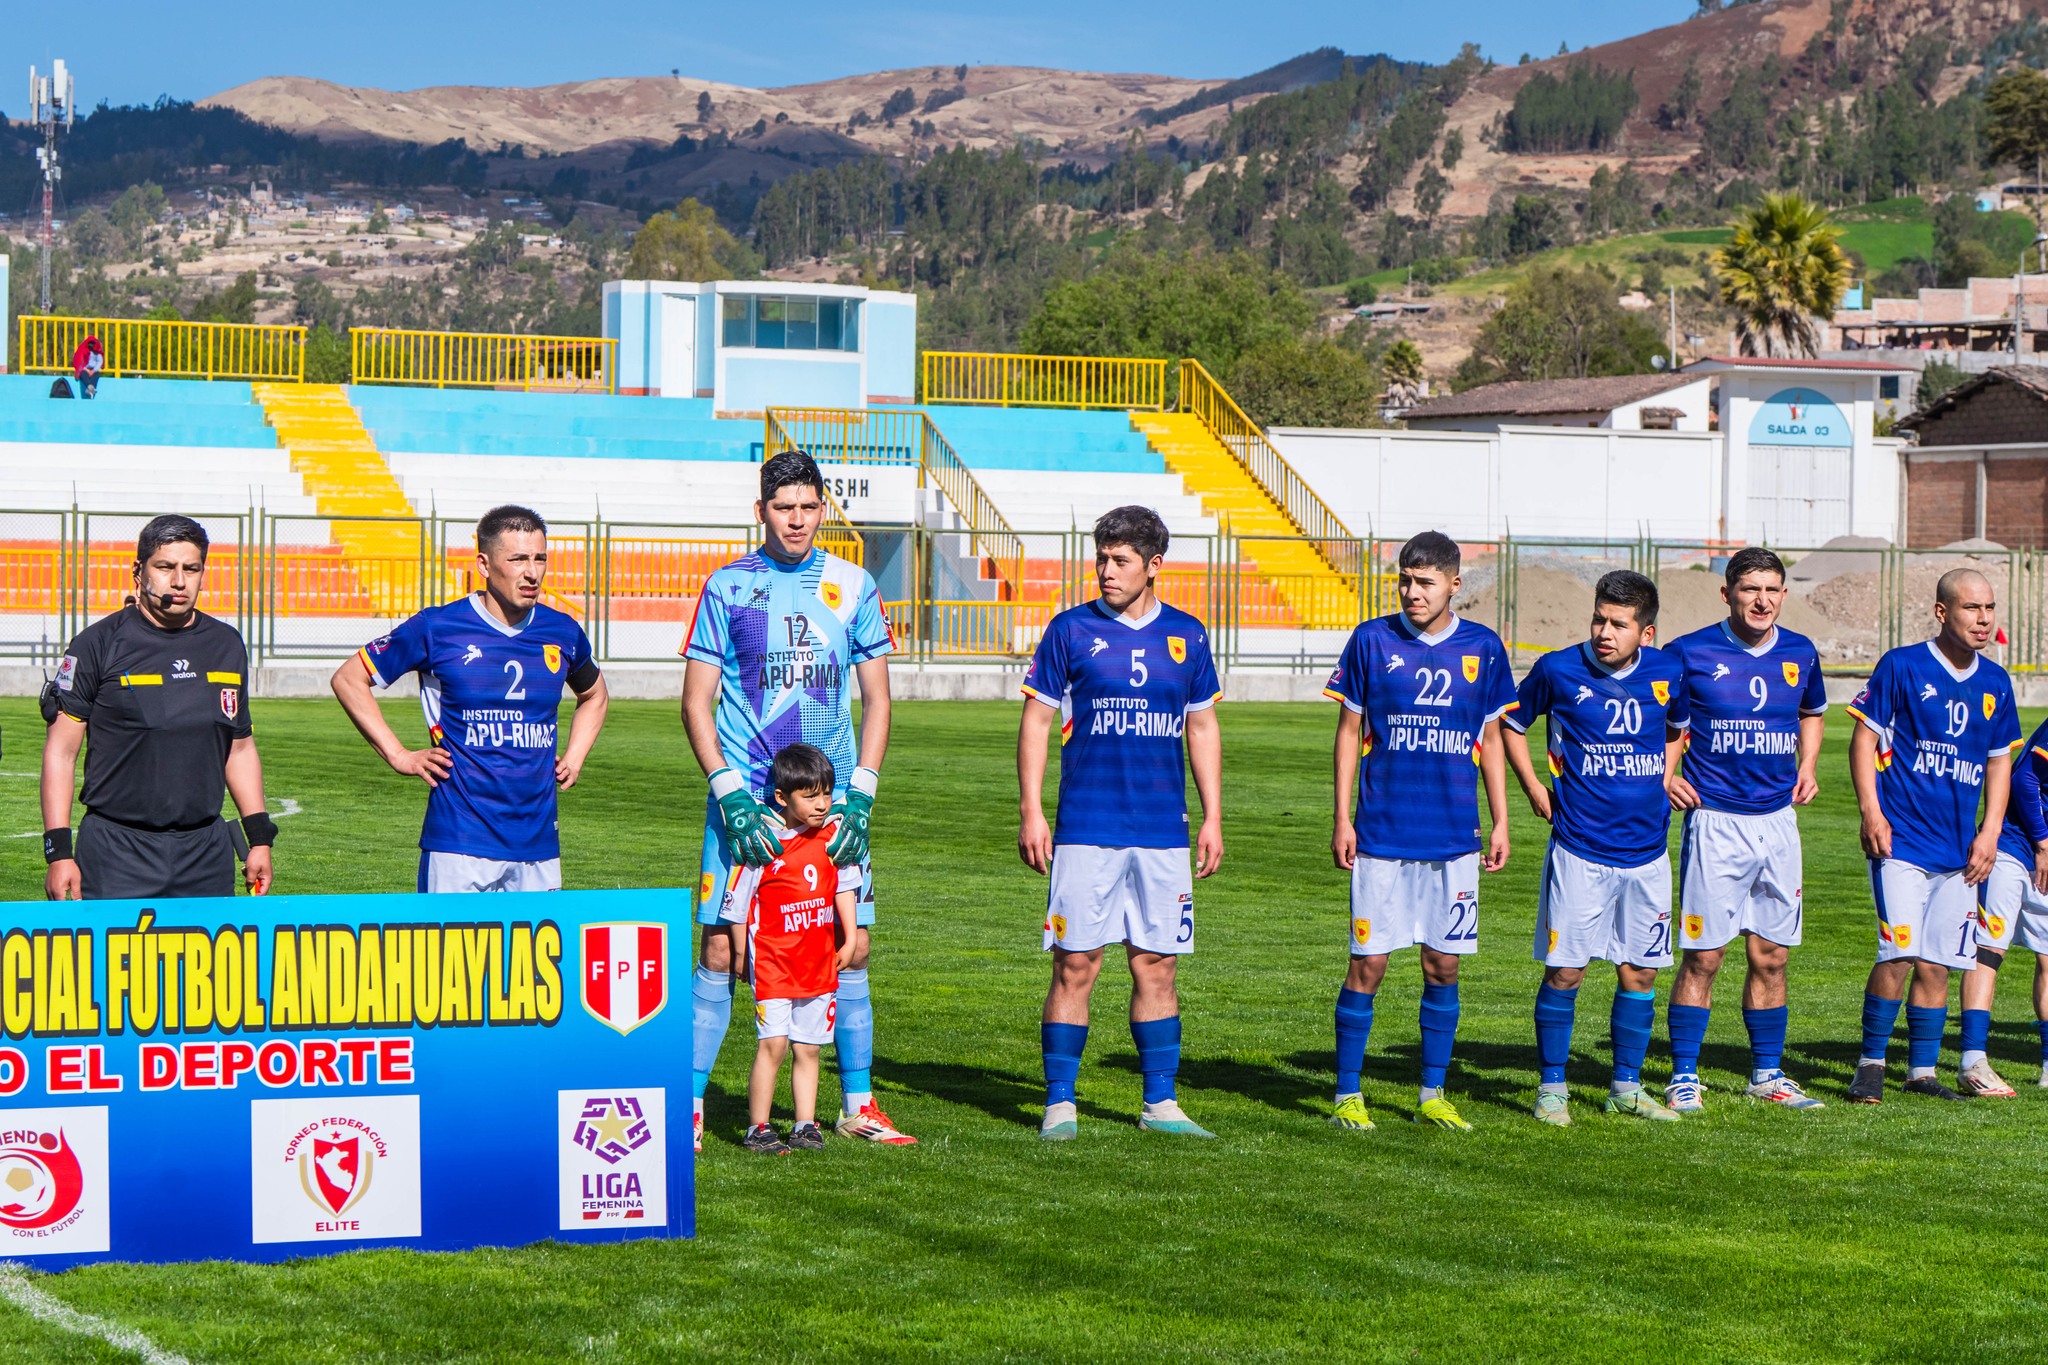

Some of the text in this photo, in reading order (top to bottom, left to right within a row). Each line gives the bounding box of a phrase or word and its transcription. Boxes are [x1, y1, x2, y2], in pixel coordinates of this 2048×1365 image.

[767, 424, 829, 436] SALIDA 03
[784, 614, 811, 647] 12
[756, 651, 814, 664] INSTITUTO
[1129, 648, 1148, 688] 5
[171, 671, 197, 679] walon
[504, 659, 526, 700] 2
[1413, 667, 1453, 707] 22
[1091, 697, 1149, 710] INSTITUTO
[1749, 675, 1768, 712] 9
[462, 709, 524, 721] INSTITUTO
[1090, 711, 1183, 738] APU-RIMAC
[1387, 714, 1440, 727] INSTITUTO
[1604, 697, 1642, 735] 20
[1710, 719, 1766, 731] INSTITUTO
[1945, 699, 1969, 738] 19
[464, 722, 556, 748] APU-RIMAC
[1388, 727, 1471, 755] APU-RIMAC
[1710, 731, 1798, 755] APU-RIMAC
[1581, 752, 1665, 777] APU-RIMAC
[803, 863, 818, 892] 9
[780, 897, 826, 914] INSTITUTO
[1176, 902, 1193, 943] 5
[1444, 900, 1478, 941] 22
[107, 911, 265, 1033] FÚTBOL
[271, 922, 563, 1029] ANDAHUAYLAS
[826, 1000, 837, 1032] 9
[48, 1046, 121, 1093] EL
[140, 1037, 413, 1091] DEPORTE
[285, 1117, 387, 1162] TORNEO FEDERACIÓN
[582, 1172, 643, 1199] LIGA
[582, 1200, 644, 1210] FEMENINA
[12, 1208, 85, 1238] CON EL FÚTBOL
[315, 1220, 360, 1232] ELITE
